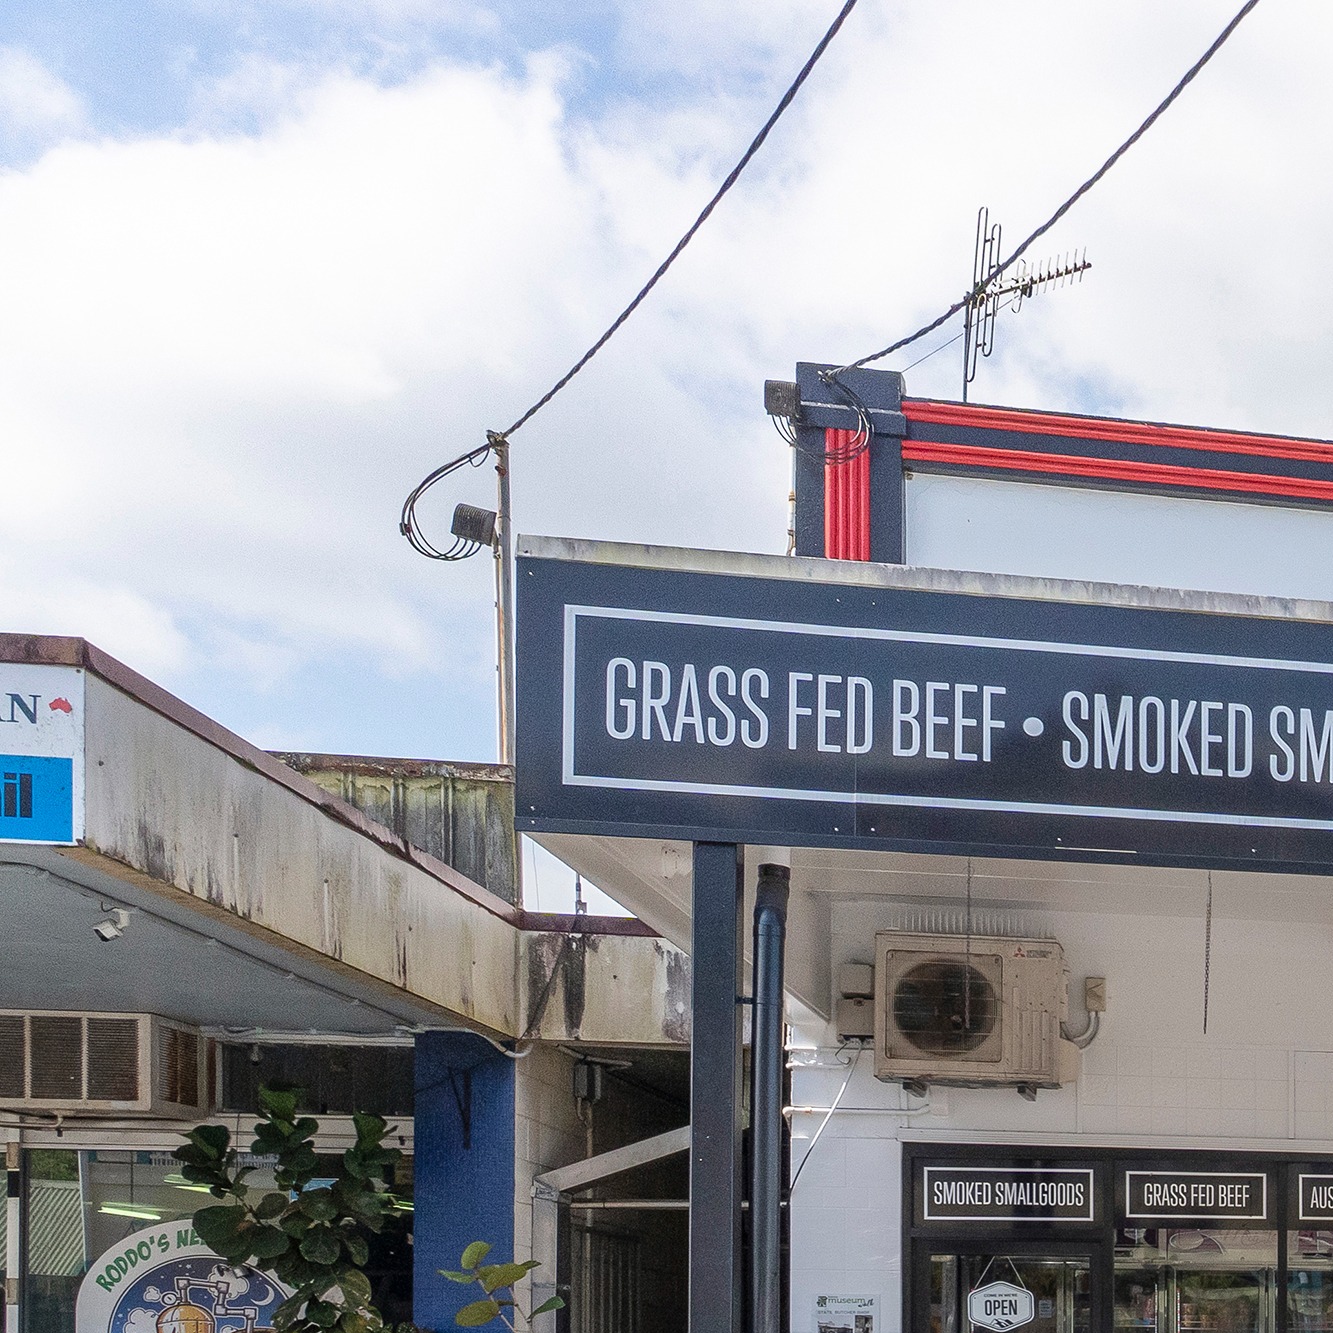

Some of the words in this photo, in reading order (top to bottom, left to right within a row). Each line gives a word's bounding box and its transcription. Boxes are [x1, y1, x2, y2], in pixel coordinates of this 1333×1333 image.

[0, 693, 42, 724] N
[604, 655, 770, 748] GRASS
[787, 671, 871, 755] FED
[891, 680, 1007, 763] BEEF
[1061, 690, 1254, 780] SMOKED
[0, 772, 33, 818] il
[933, 1182, 992, 1206] SMOKED
[995, 1182, 1085, 1207] SMALLGOODS
[1143, 1183, 1188, 1207] GRASS
[1190, 1183, 1215, 1207] FED
[1218, 1184, 1250, 1207] BEEF
[96, 1233, 170, 1293] RODDO'S
[177, 1229, 207, 1249] NE
[984, 1299, 1018, 1316] OPEN
